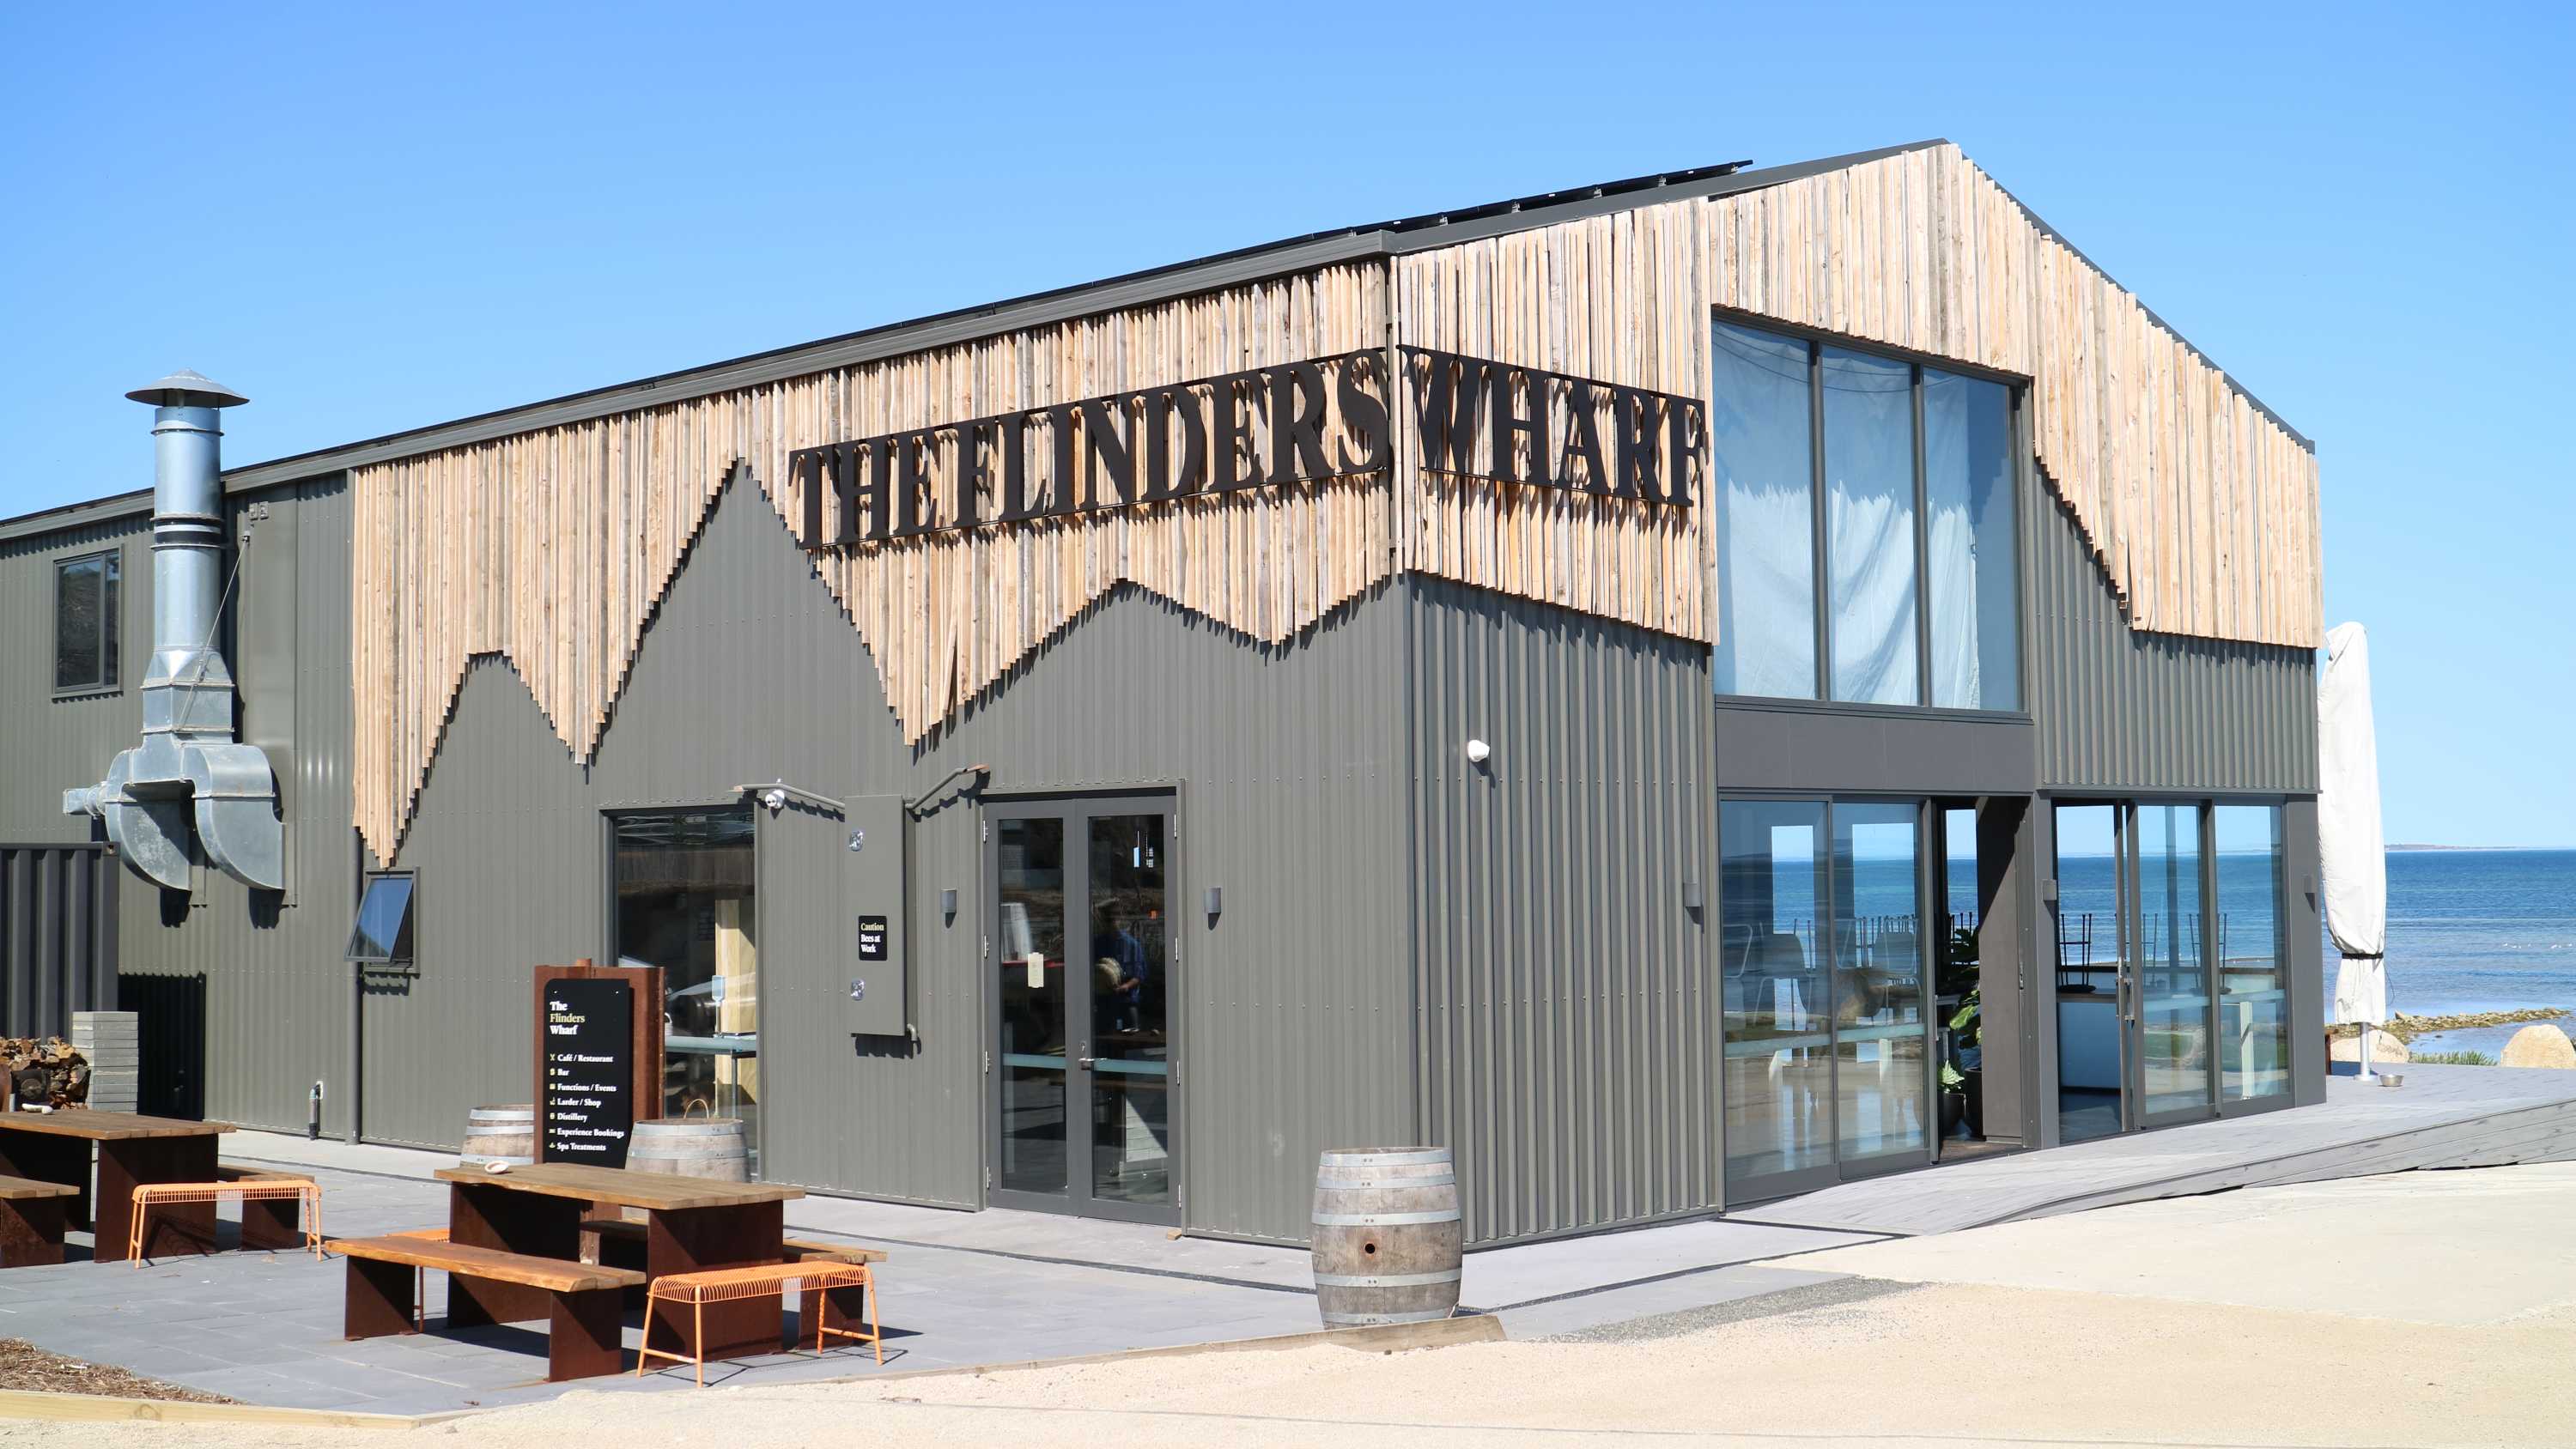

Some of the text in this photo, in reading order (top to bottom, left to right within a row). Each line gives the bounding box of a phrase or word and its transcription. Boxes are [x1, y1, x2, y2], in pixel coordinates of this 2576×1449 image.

[1396, 344, 1705, 506] WHARF
[550, 1001, 568, 1010] The
[550, 1013, 586, 1023] Flinders
[550, 1025, 578, 1034] Wharf
[594, 1083, 617, 1092] Events
[584, 1099, 601, 1107] Shop
[557, 1113, 587, 1122] Distillery
[557, 1128, 624, 1138] Experience Bookings
[557, 1143, 568, 1151] Spa
